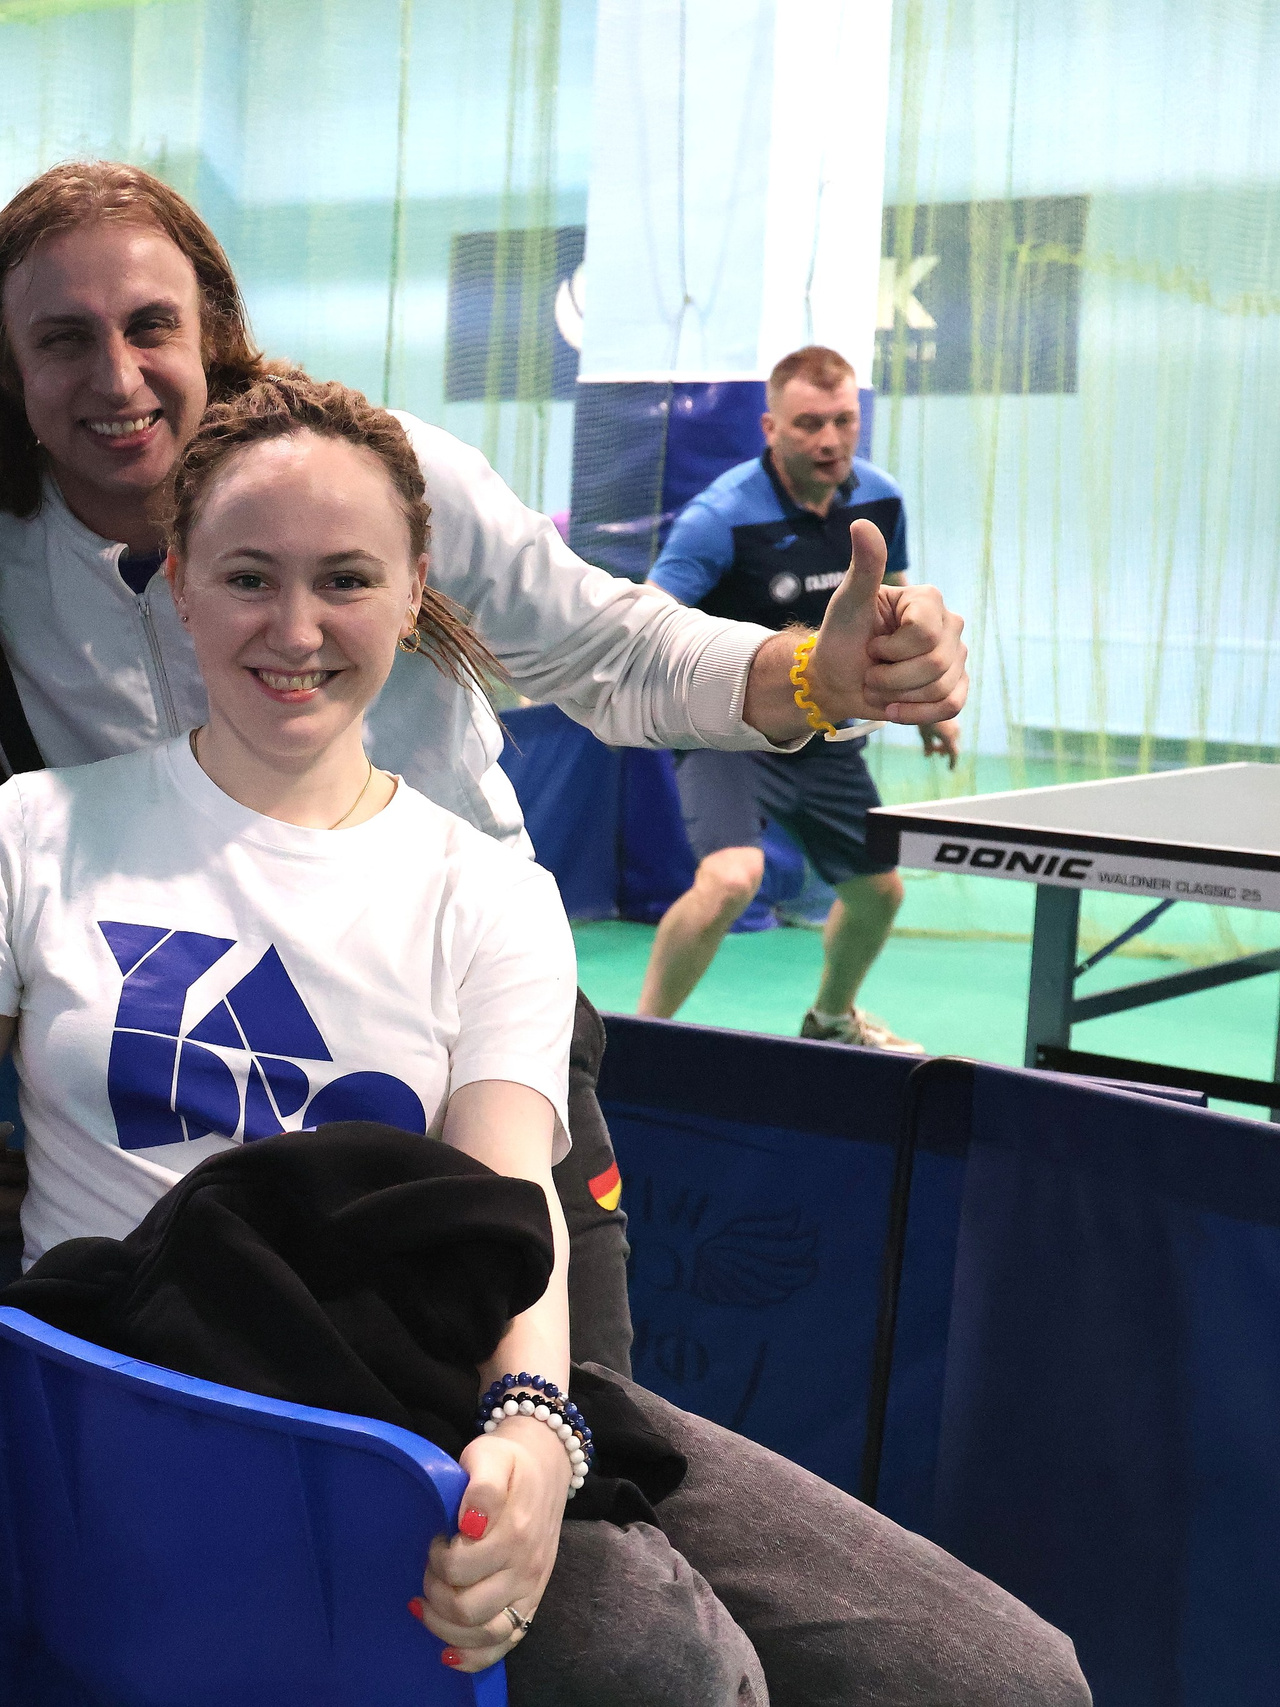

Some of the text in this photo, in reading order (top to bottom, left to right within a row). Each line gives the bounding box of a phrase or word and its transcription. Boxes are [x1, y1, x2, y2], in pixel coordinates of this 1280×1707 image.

[935, 843, 1262, 902] DONIC WALDNER CLASSIC 25
